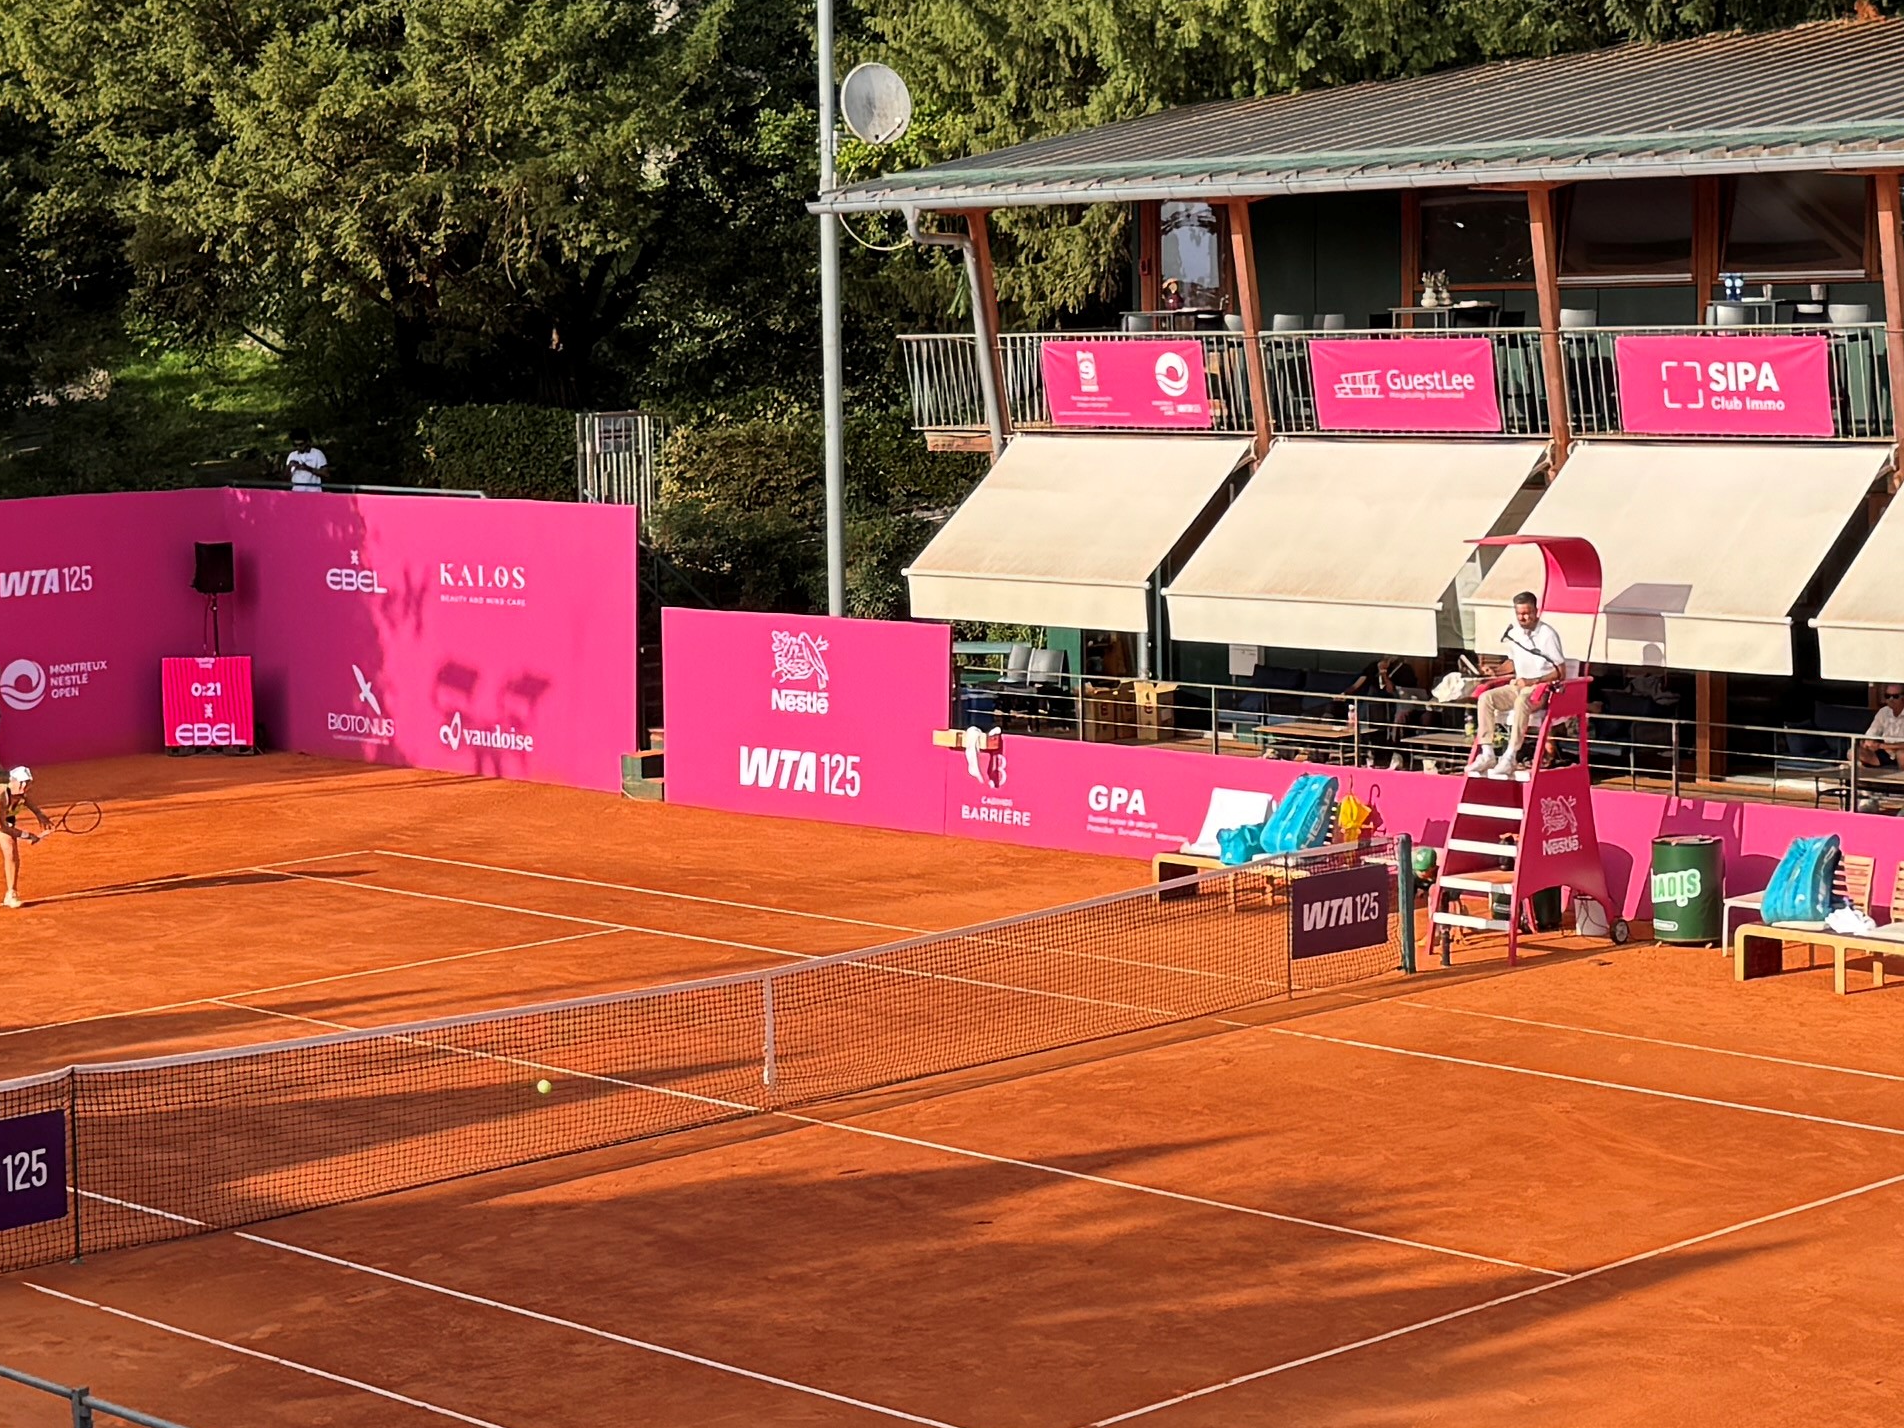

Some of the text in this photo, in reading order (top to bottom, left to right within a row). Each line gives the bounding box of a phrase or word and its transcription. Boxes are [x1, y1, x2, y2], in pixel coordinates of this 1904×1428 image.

[1386, 369, 1475, 391] GuestLee
[1708, 361, 1780, 392] SIPA
[1711, 396, 1785, 411] Club Immo
[0, 566, 92, 598] WTA 125
[326, 568, 387, 593] EBEL
[440, 563, 525, 589] KALOS
[49, 660, 107, 674] MONTREUX
[51, 687, 79, 699] OPEN
[191, 682, 221, 697] 0:21
[175, 723, 246, 746] EBEL
[463, 724, 534, 752] vaudoise
[740, 745, 861, 797] WTA 125
[1088, 785, 1146, 816] GPA
[961, 805, 1031, 827] BARRIÈRE
[1303, 892, 1379, 932] WTA 125
[2, 1148, 47, 1193] 125
